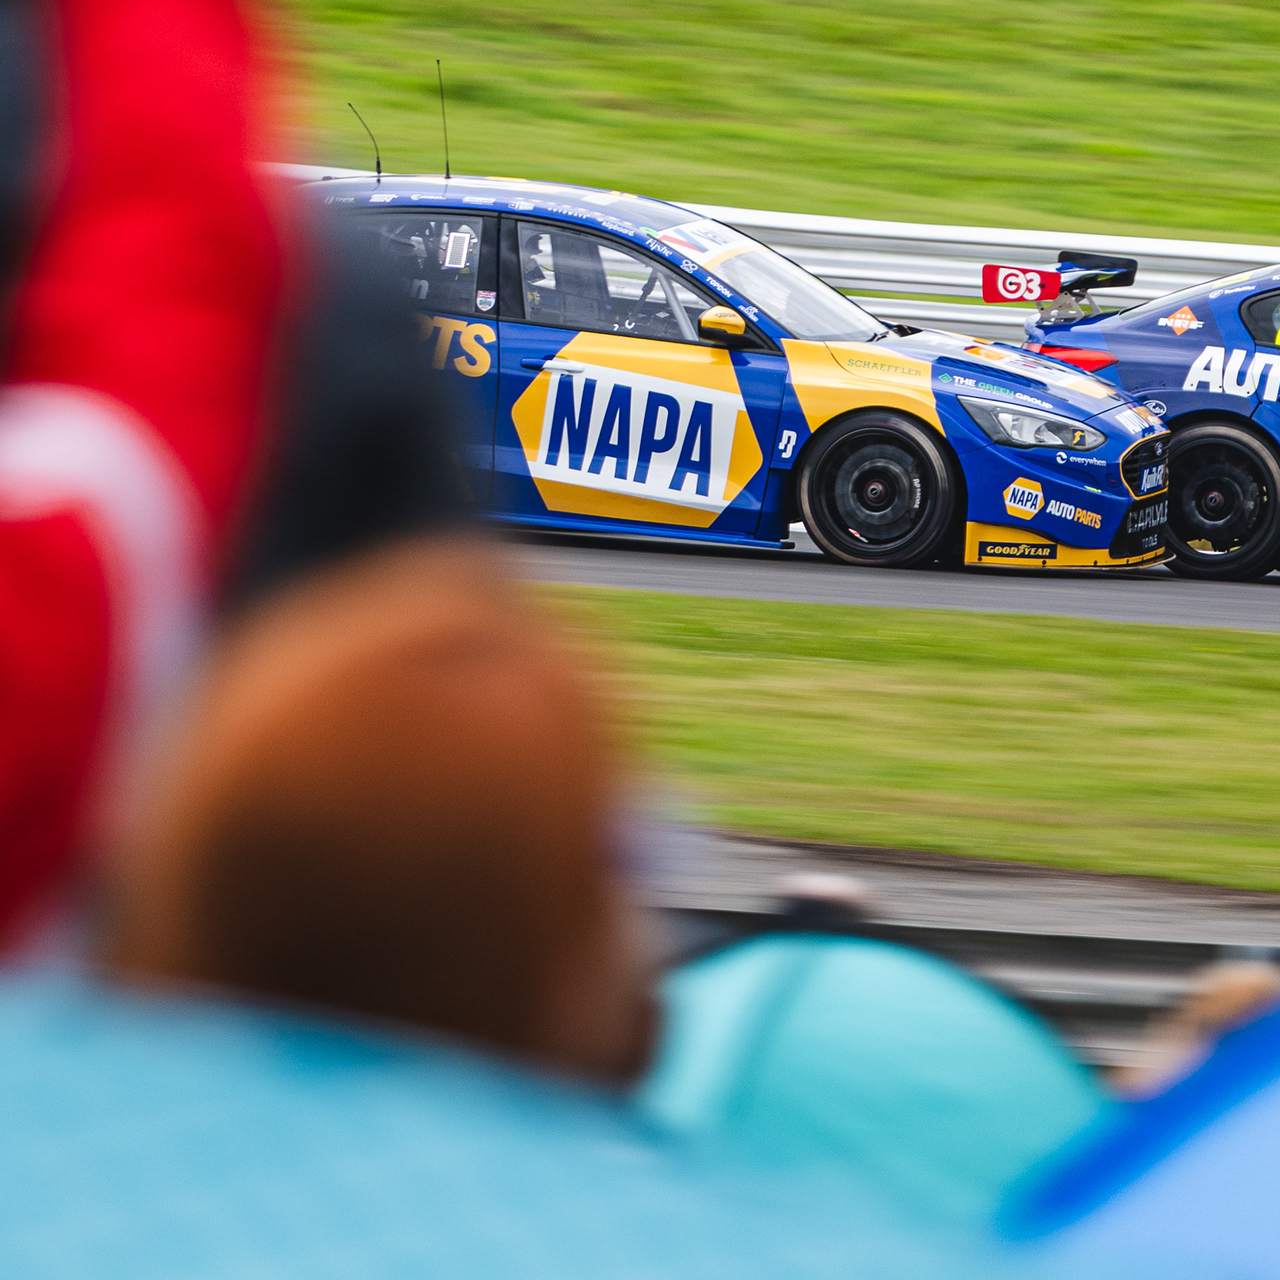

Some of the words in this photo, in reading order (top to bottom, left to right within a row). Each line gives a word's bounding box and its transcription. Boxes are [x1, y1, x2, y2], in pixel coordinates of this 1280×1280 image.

[705, 276, 732, 298] TOPDON
[997, 267, 1042, 300] G3
[1157, 317, 1205, 330] NRF
[847, 358, 922, 377] SCHAEFFLER
[953, 375, 976, 387] THE
[978, 382, 1015, 396] GREEN
[1015, 392, 1054, 409] GROUP
[545, 373, 713, 497] NAPA
[1069, 455, 1107, 467] everywhen
[1009, 486, 1039, 511] NAPA
[1046, 499, 1075, 521] AUTO
[1074, 508, 1101, 529] PARTS
[986, 543, 1051, 557] GOODYEAR
